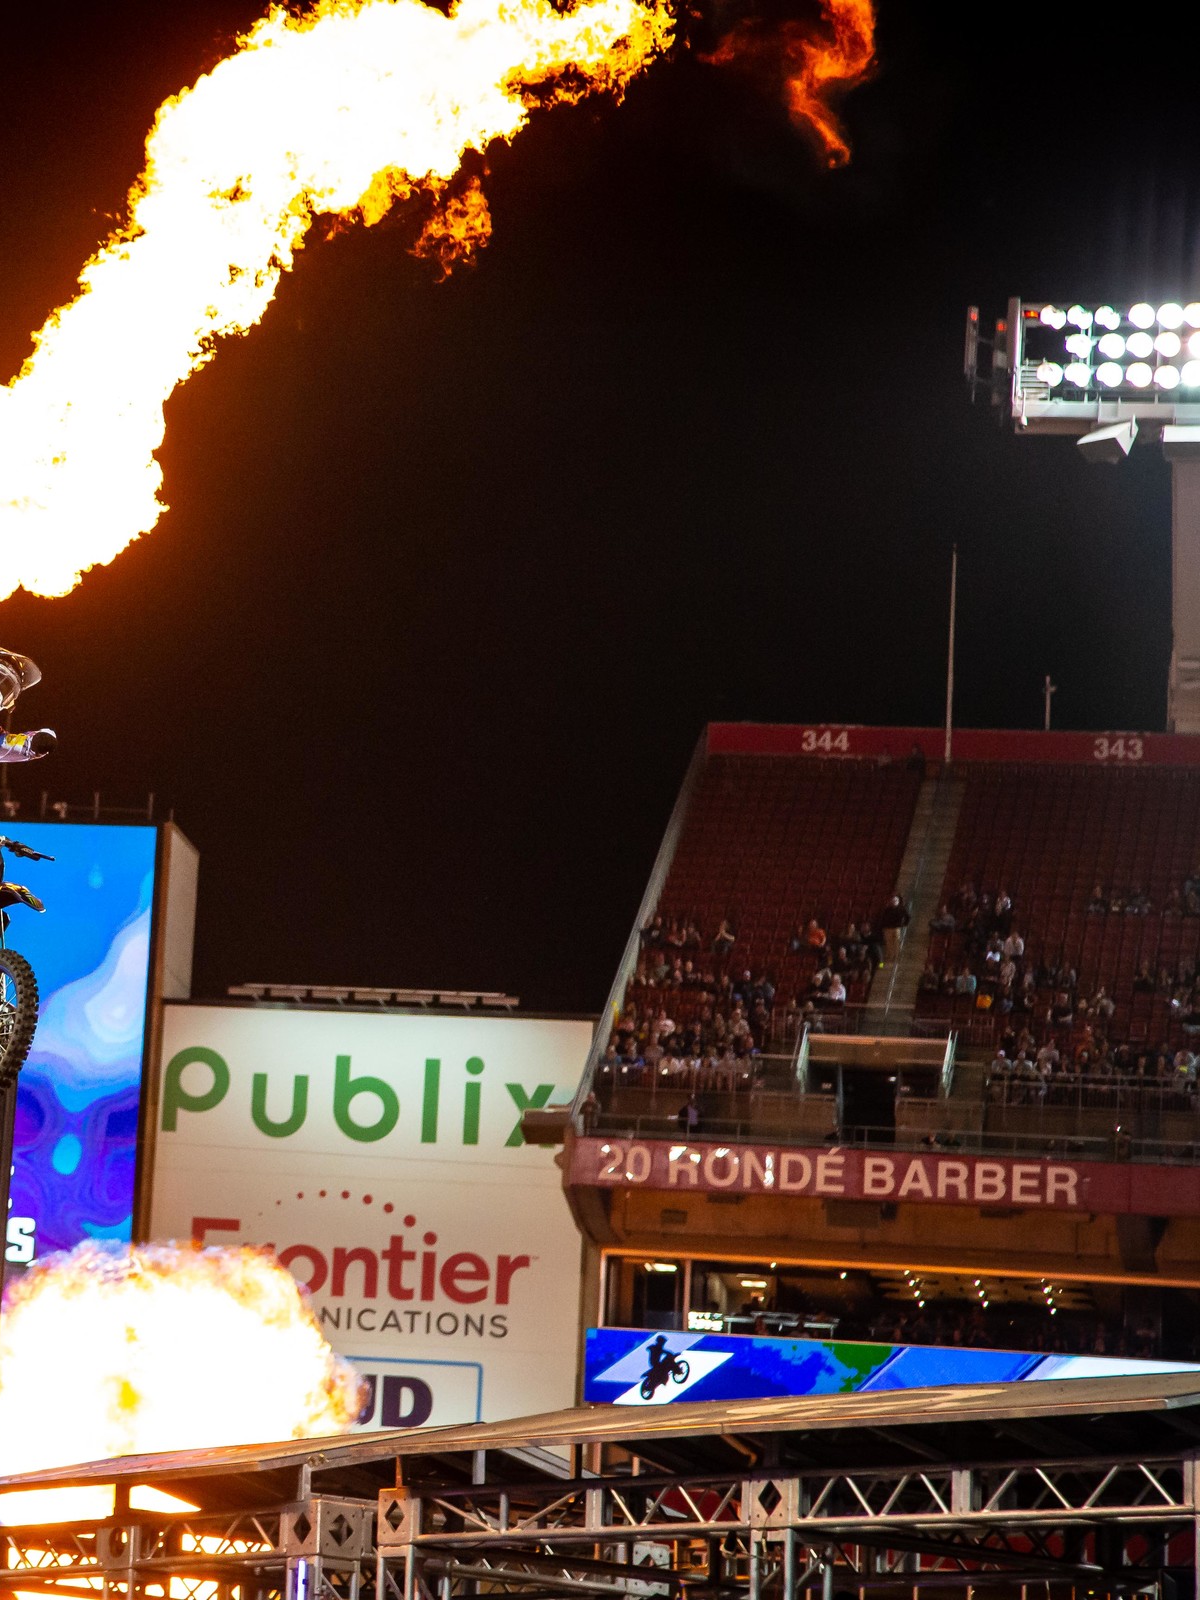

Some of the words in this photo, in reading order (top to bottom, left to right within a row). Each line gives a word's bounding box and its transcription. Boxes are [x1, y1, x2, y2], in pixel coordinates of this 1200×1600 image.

[801, 730, 850, 752] 344
[1093, 738, 1144, 761] 343
[161, 1045, 556, 1148] Publix
[597, 1144, 652, 1184] 20
[668, 1145, 847, 1193] RONDÉ
[863, 1156, 1079, 1205] BARBER
